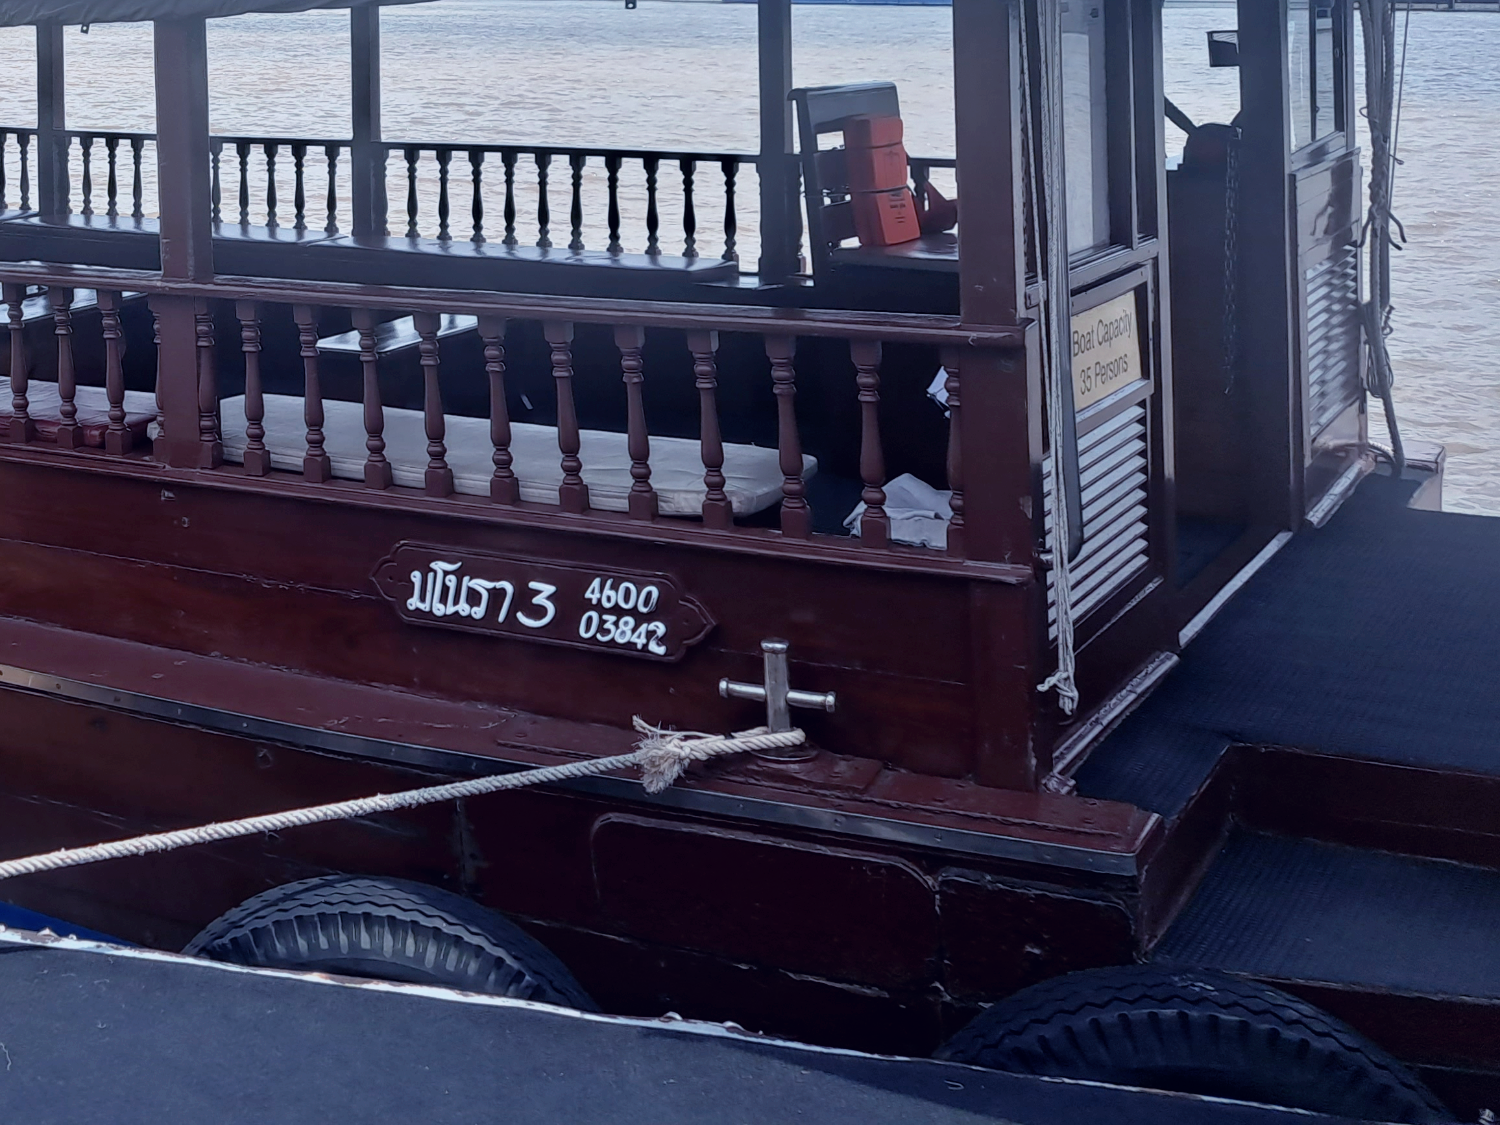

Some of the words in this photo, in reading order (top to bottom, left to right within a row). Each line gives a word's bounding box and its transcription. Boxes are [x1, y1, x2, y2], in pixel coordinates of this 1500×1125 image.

[1072, 325, 1095, 357] Boat
[1096, 309, 1132, 349] Capacity
[1079, 365, 1092, 396] 35
[1094, 353, 1129, 389] Persons
[516, 580, 557, 628] 3
[583, 577, 660, 614] 4600
[578, 610, 667, 656] 03842
